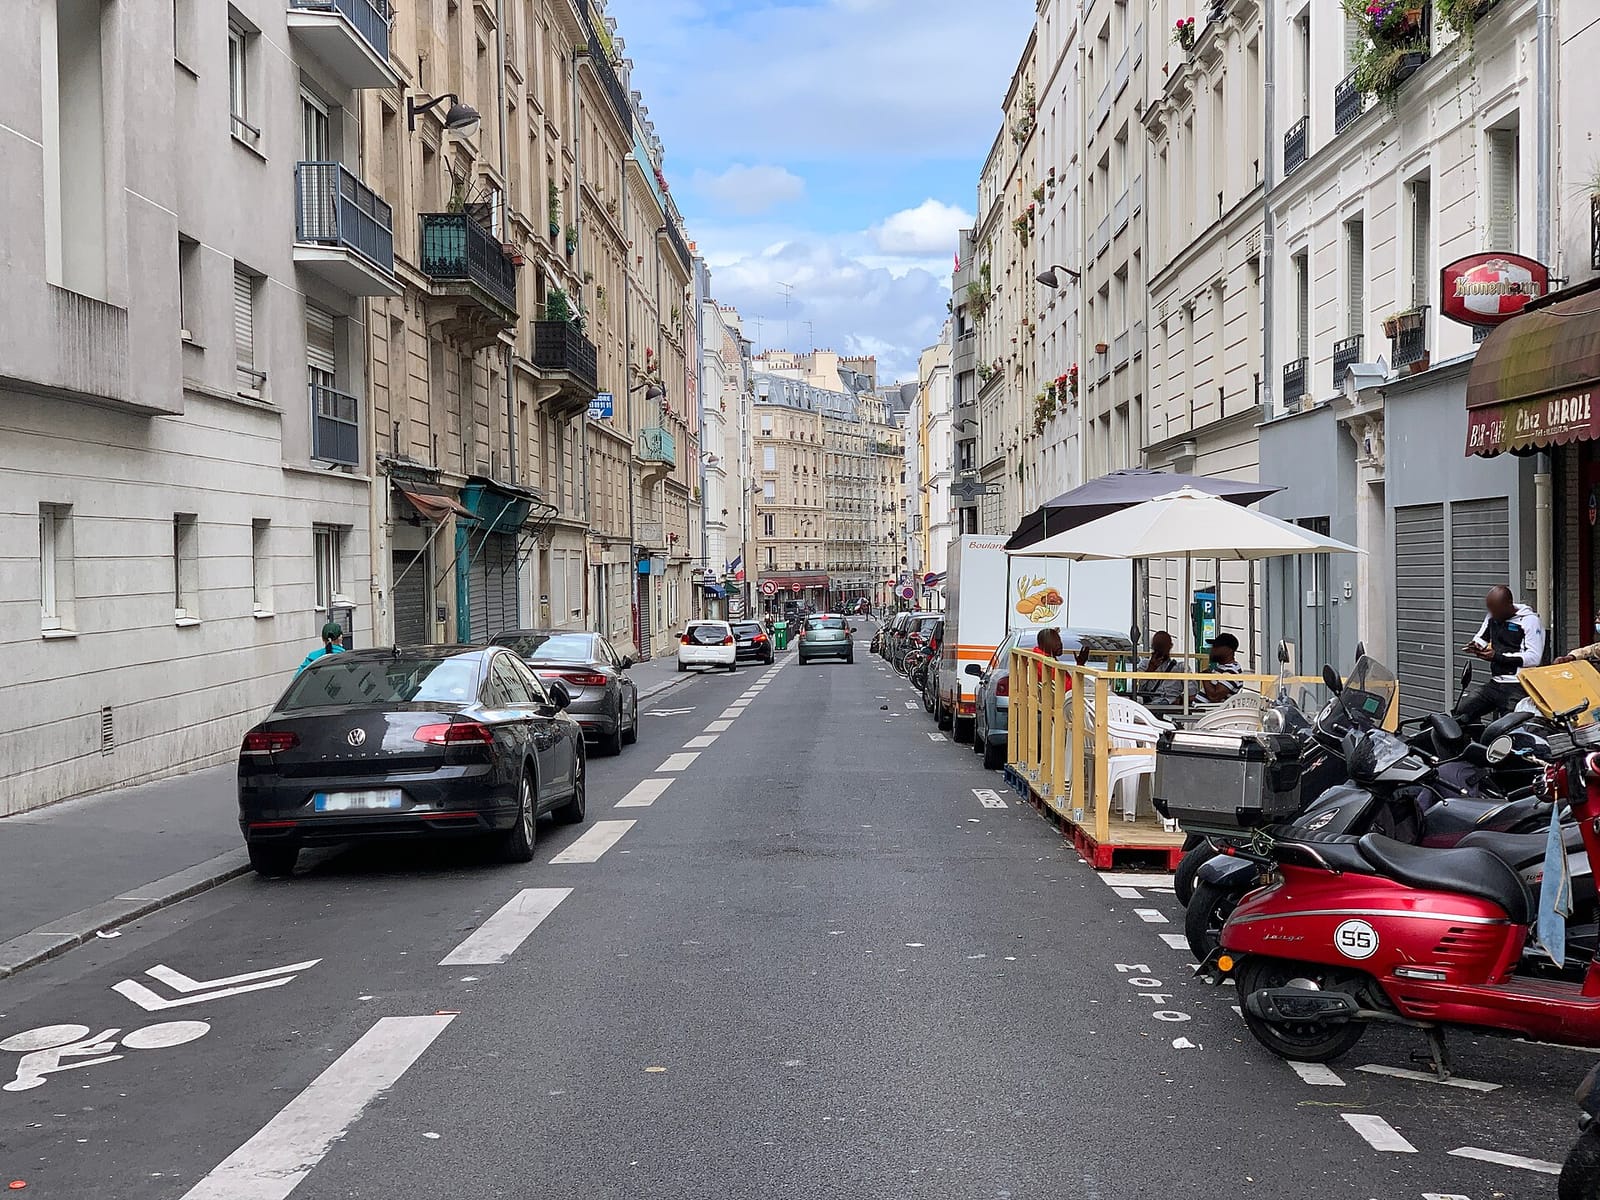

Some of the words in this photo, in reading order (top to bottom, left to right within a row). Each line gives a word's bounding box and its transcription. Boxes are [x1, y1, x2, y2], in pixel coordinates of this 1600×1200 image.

[1454, 276, 1541, 299] Kronenburg
[1516, 408, 1540, 432] Chez
[1547, 393, 1591, 426] CAROLE
[1342, 930, 1371, 949] 55
[1114, 963, 1192, 1022] MOTO
